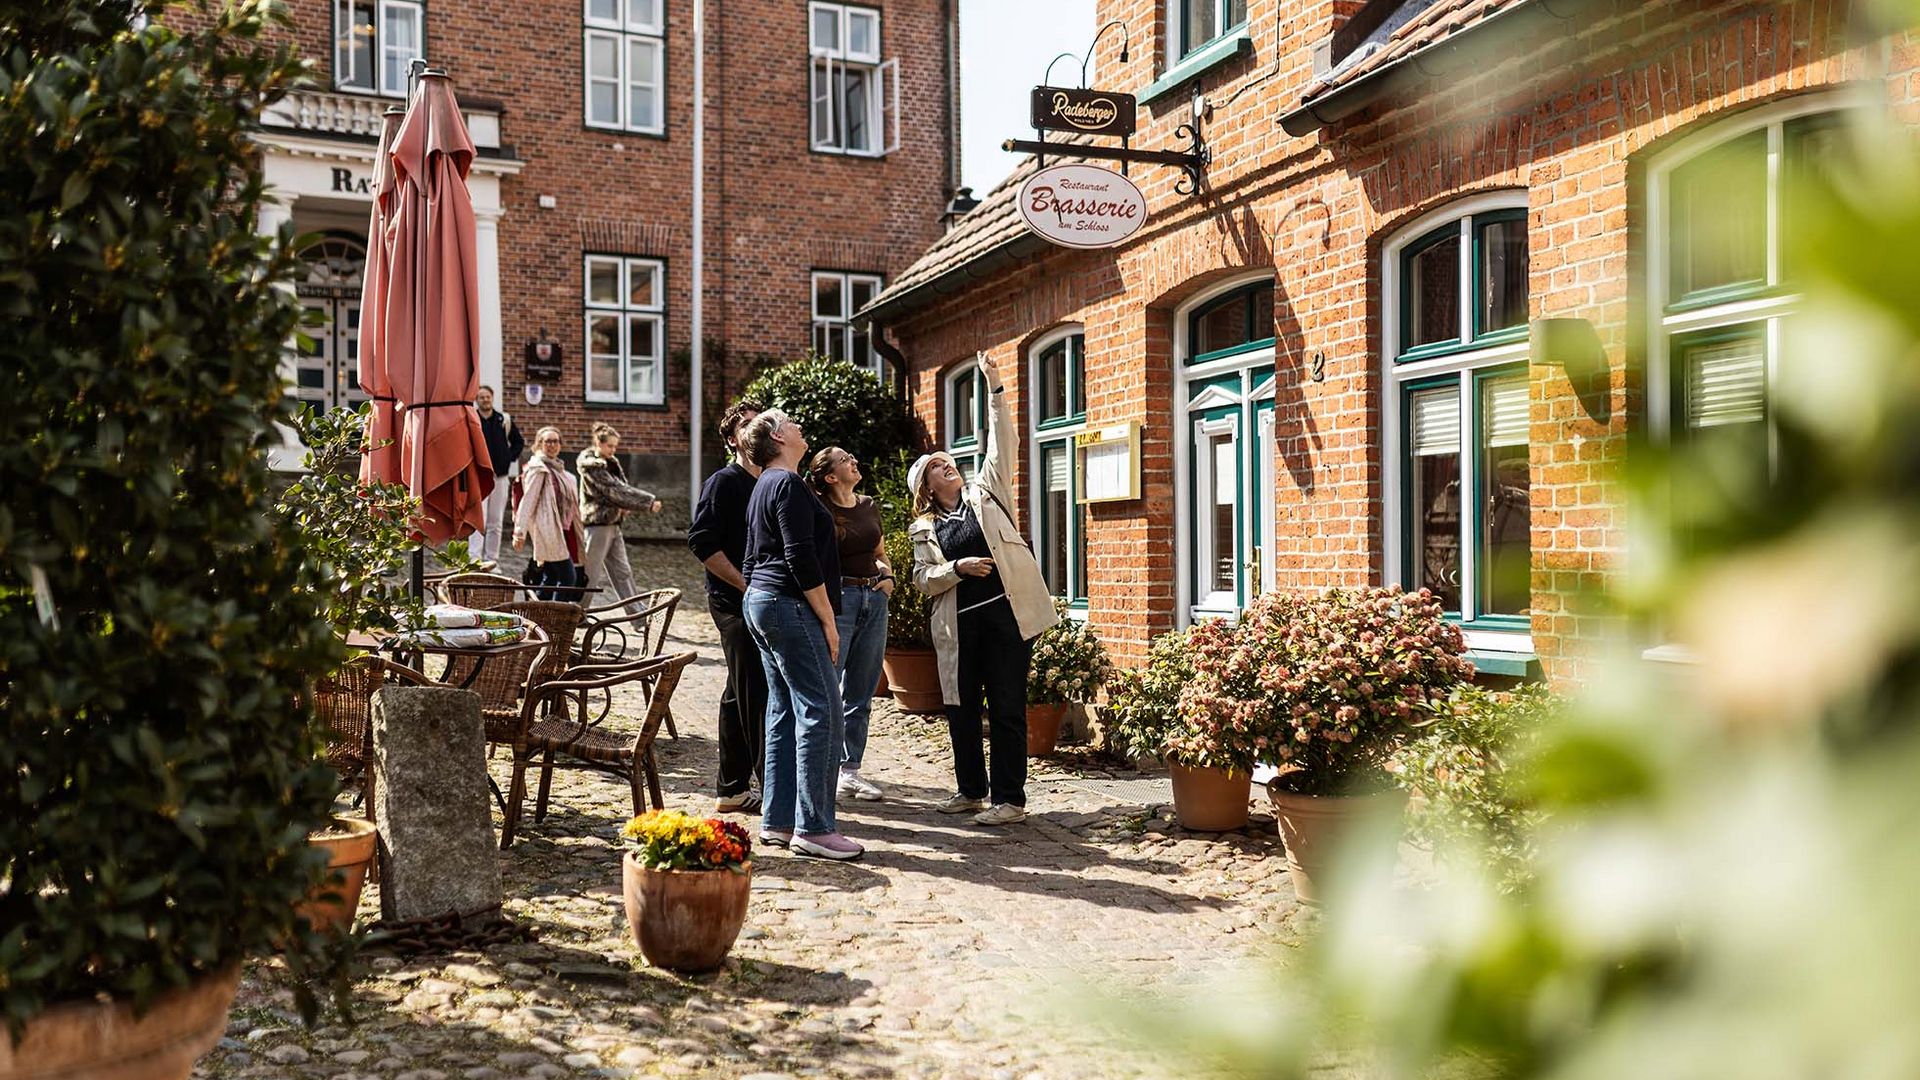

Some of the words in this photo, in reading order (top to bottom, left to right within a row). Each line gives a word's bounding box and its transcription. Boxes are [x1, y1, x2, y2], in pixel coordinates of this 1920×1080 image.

[1051, 92, 1116, 127] Radeberger
[1059, 178, 1110, 192] Restaurant
[1030, 186, 1137, 219] Brasserie
[1058, 221, 1072, 230] am
[1075, 220, 1110, 232] Schloss
[1312, 350, 1325, 382] 2
